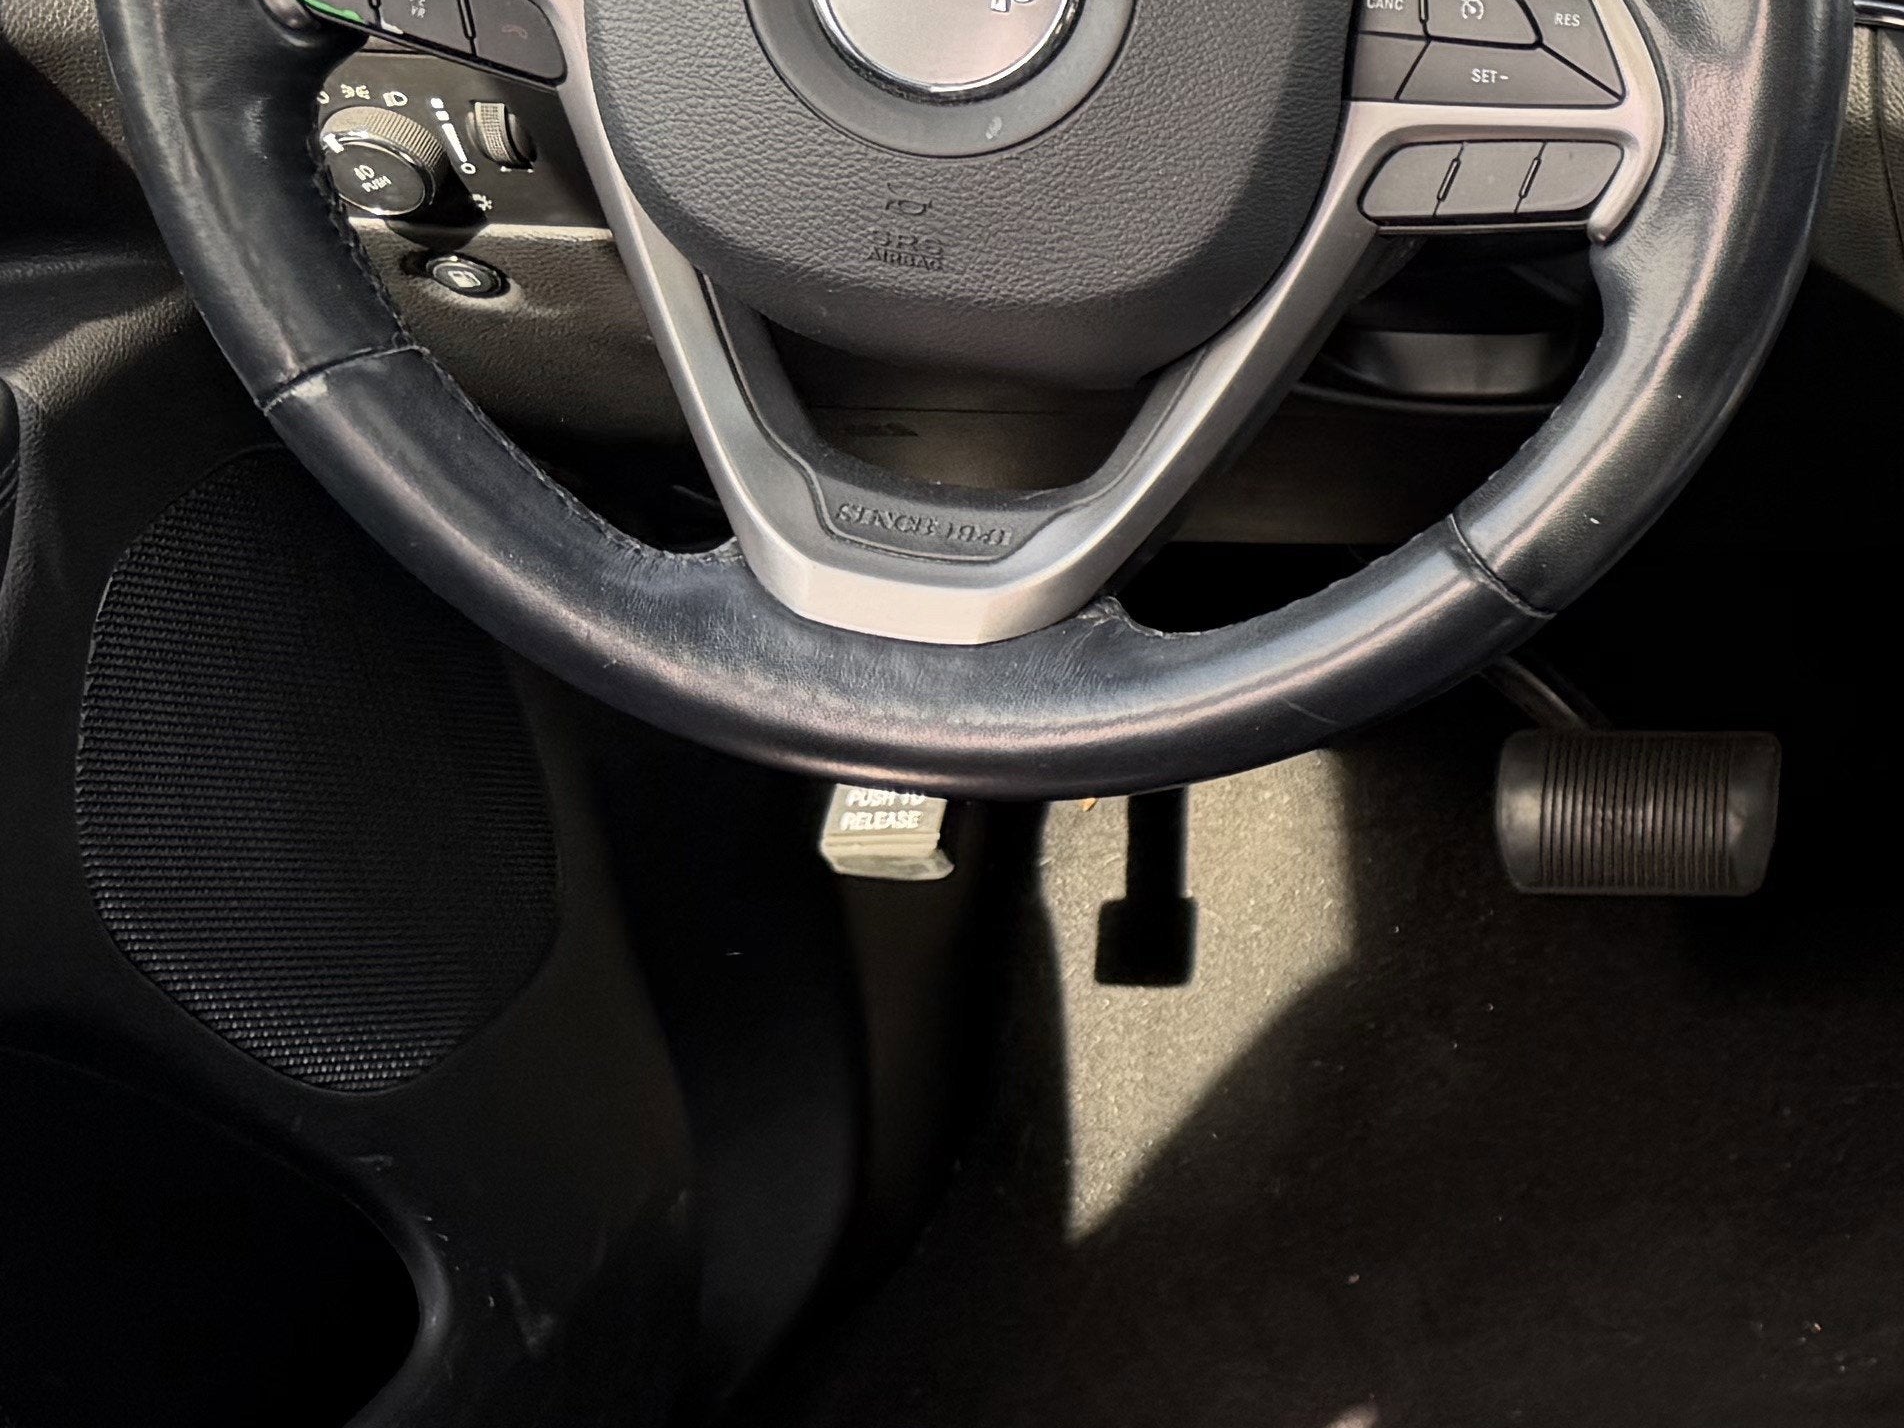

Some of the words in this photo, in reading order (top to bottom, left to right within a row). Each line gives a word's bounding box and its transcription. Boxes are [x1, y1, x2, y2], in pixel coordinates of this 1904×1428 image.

[1554, 13, 1581, 27] RES
[845, 788, 897, 808] PUSH
[840, 810, 923, 831] RELEASE
